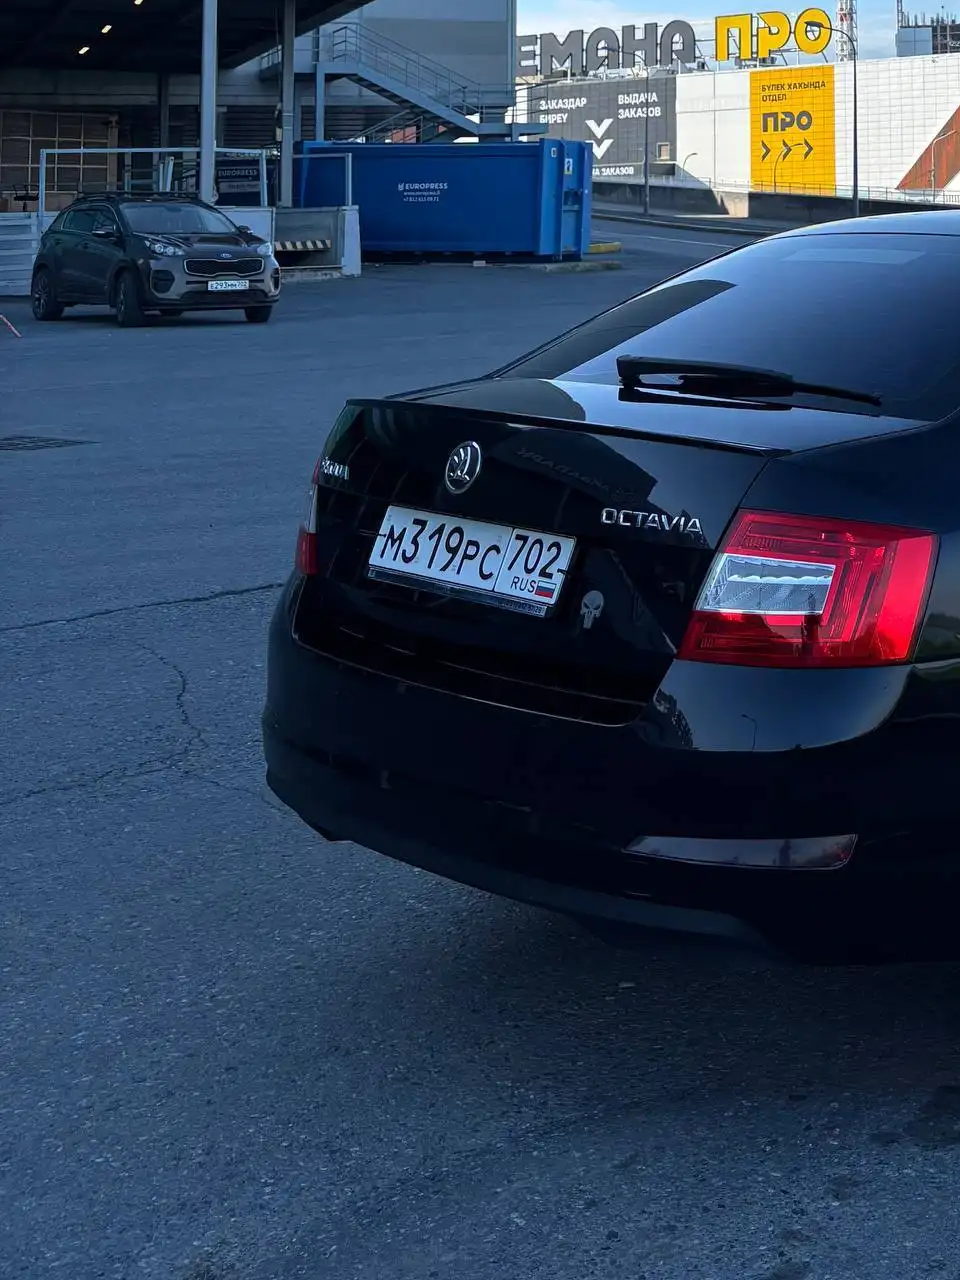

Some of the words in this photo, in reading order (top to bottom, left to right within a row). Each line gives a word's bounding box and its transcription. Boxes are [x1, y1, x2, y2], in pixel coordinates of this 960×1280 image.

[516, 19, 696, 76] ЕМАНА
[715, 7, 832, 61] ПРО
[539, 97, 587, 110] ЗАКАЗДАР
[761, 93, 787, 102] ОТДЕЛ
[618, 107, 661, 119] ЗАКАЗОВ
[762, 110, 813, 133] ПРО
[405, 182, 449, 190] EUROPRESS
[601, 507, 703, 535] OCTAVIA
[379, 518, 502, 581] М319РС
[507, 533, 562, 580] 702
[510, 576, 536, 593] RUS
